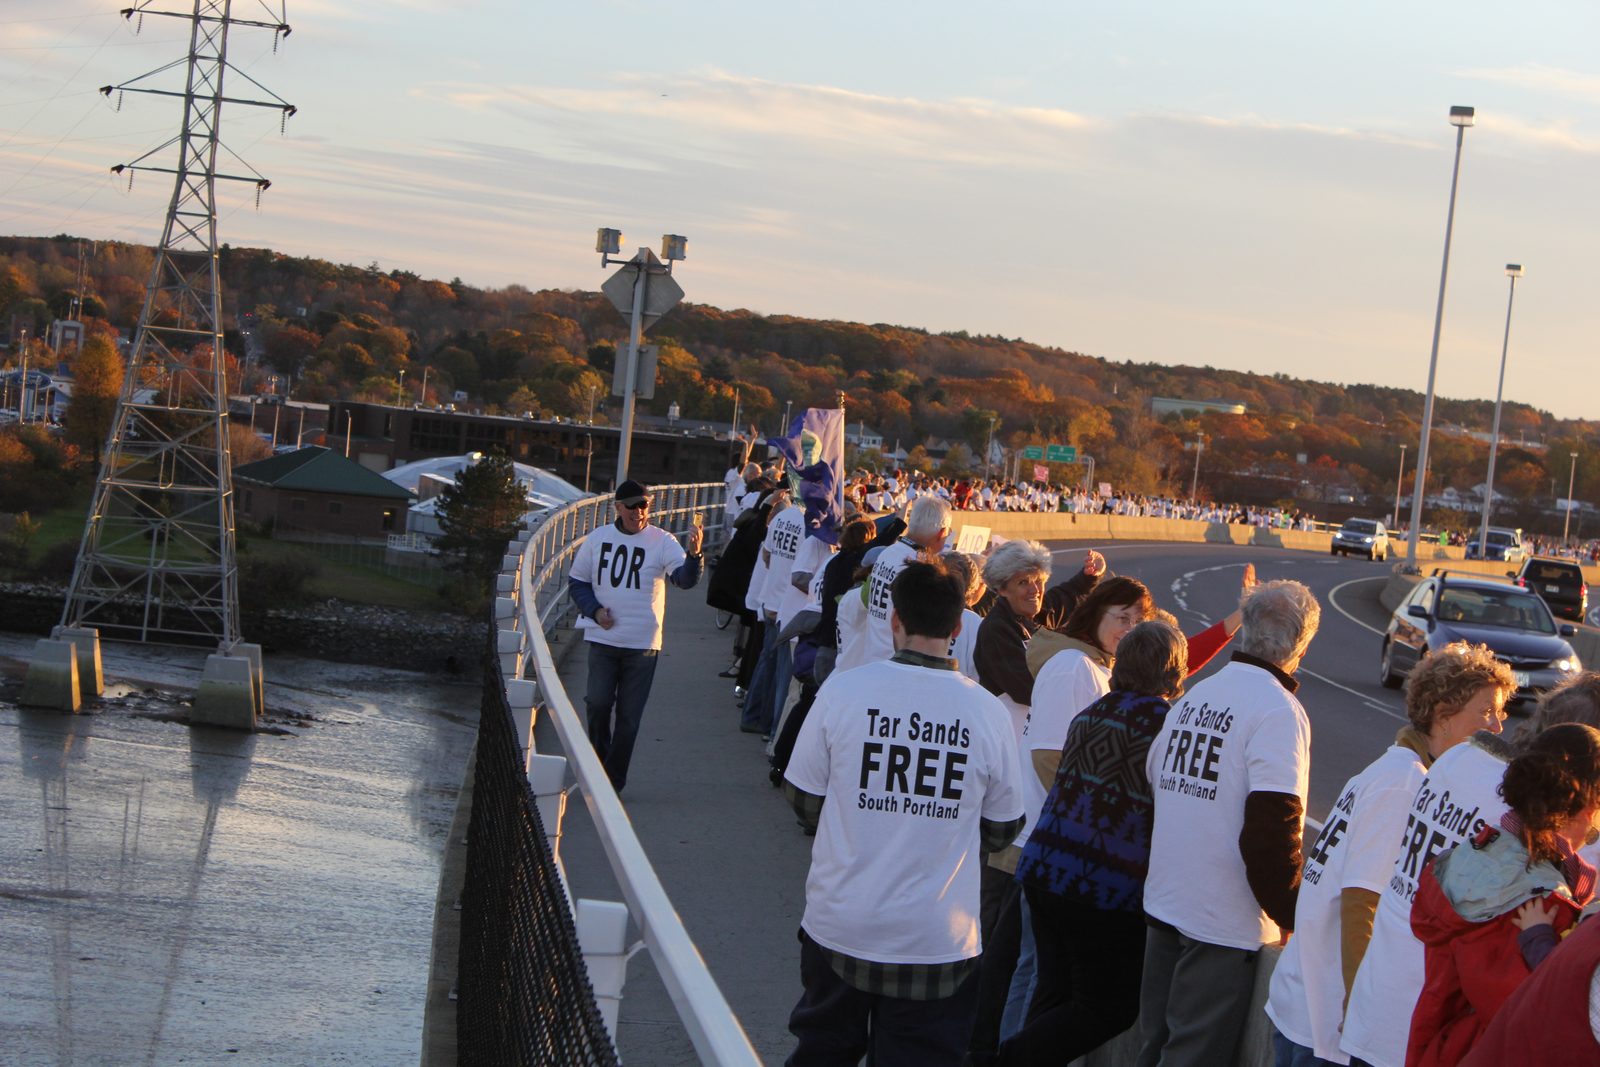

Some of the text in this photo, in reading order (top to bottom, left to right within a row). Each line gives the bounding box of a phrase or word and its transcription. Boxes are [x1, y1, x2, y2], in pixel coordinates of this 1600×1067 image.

[773, 529, 798, 553] FREE
[785, 520, 802, 535] Sands
[597, 542, 646, 590] FOR
[870, 576, 889, 609] REE
[867, 708, 970, 749] Tar Sands
[1176, 701, 1234, 734] Tar Sands
[859, 741, 968, 801] FREE
[1162, 729, 1224, 783] FREE
[858, 792, 960, 820] South Portland
[1178, 778, 1217, 801] Portland
[1412, 777, 1486, 837] Tar Sands
